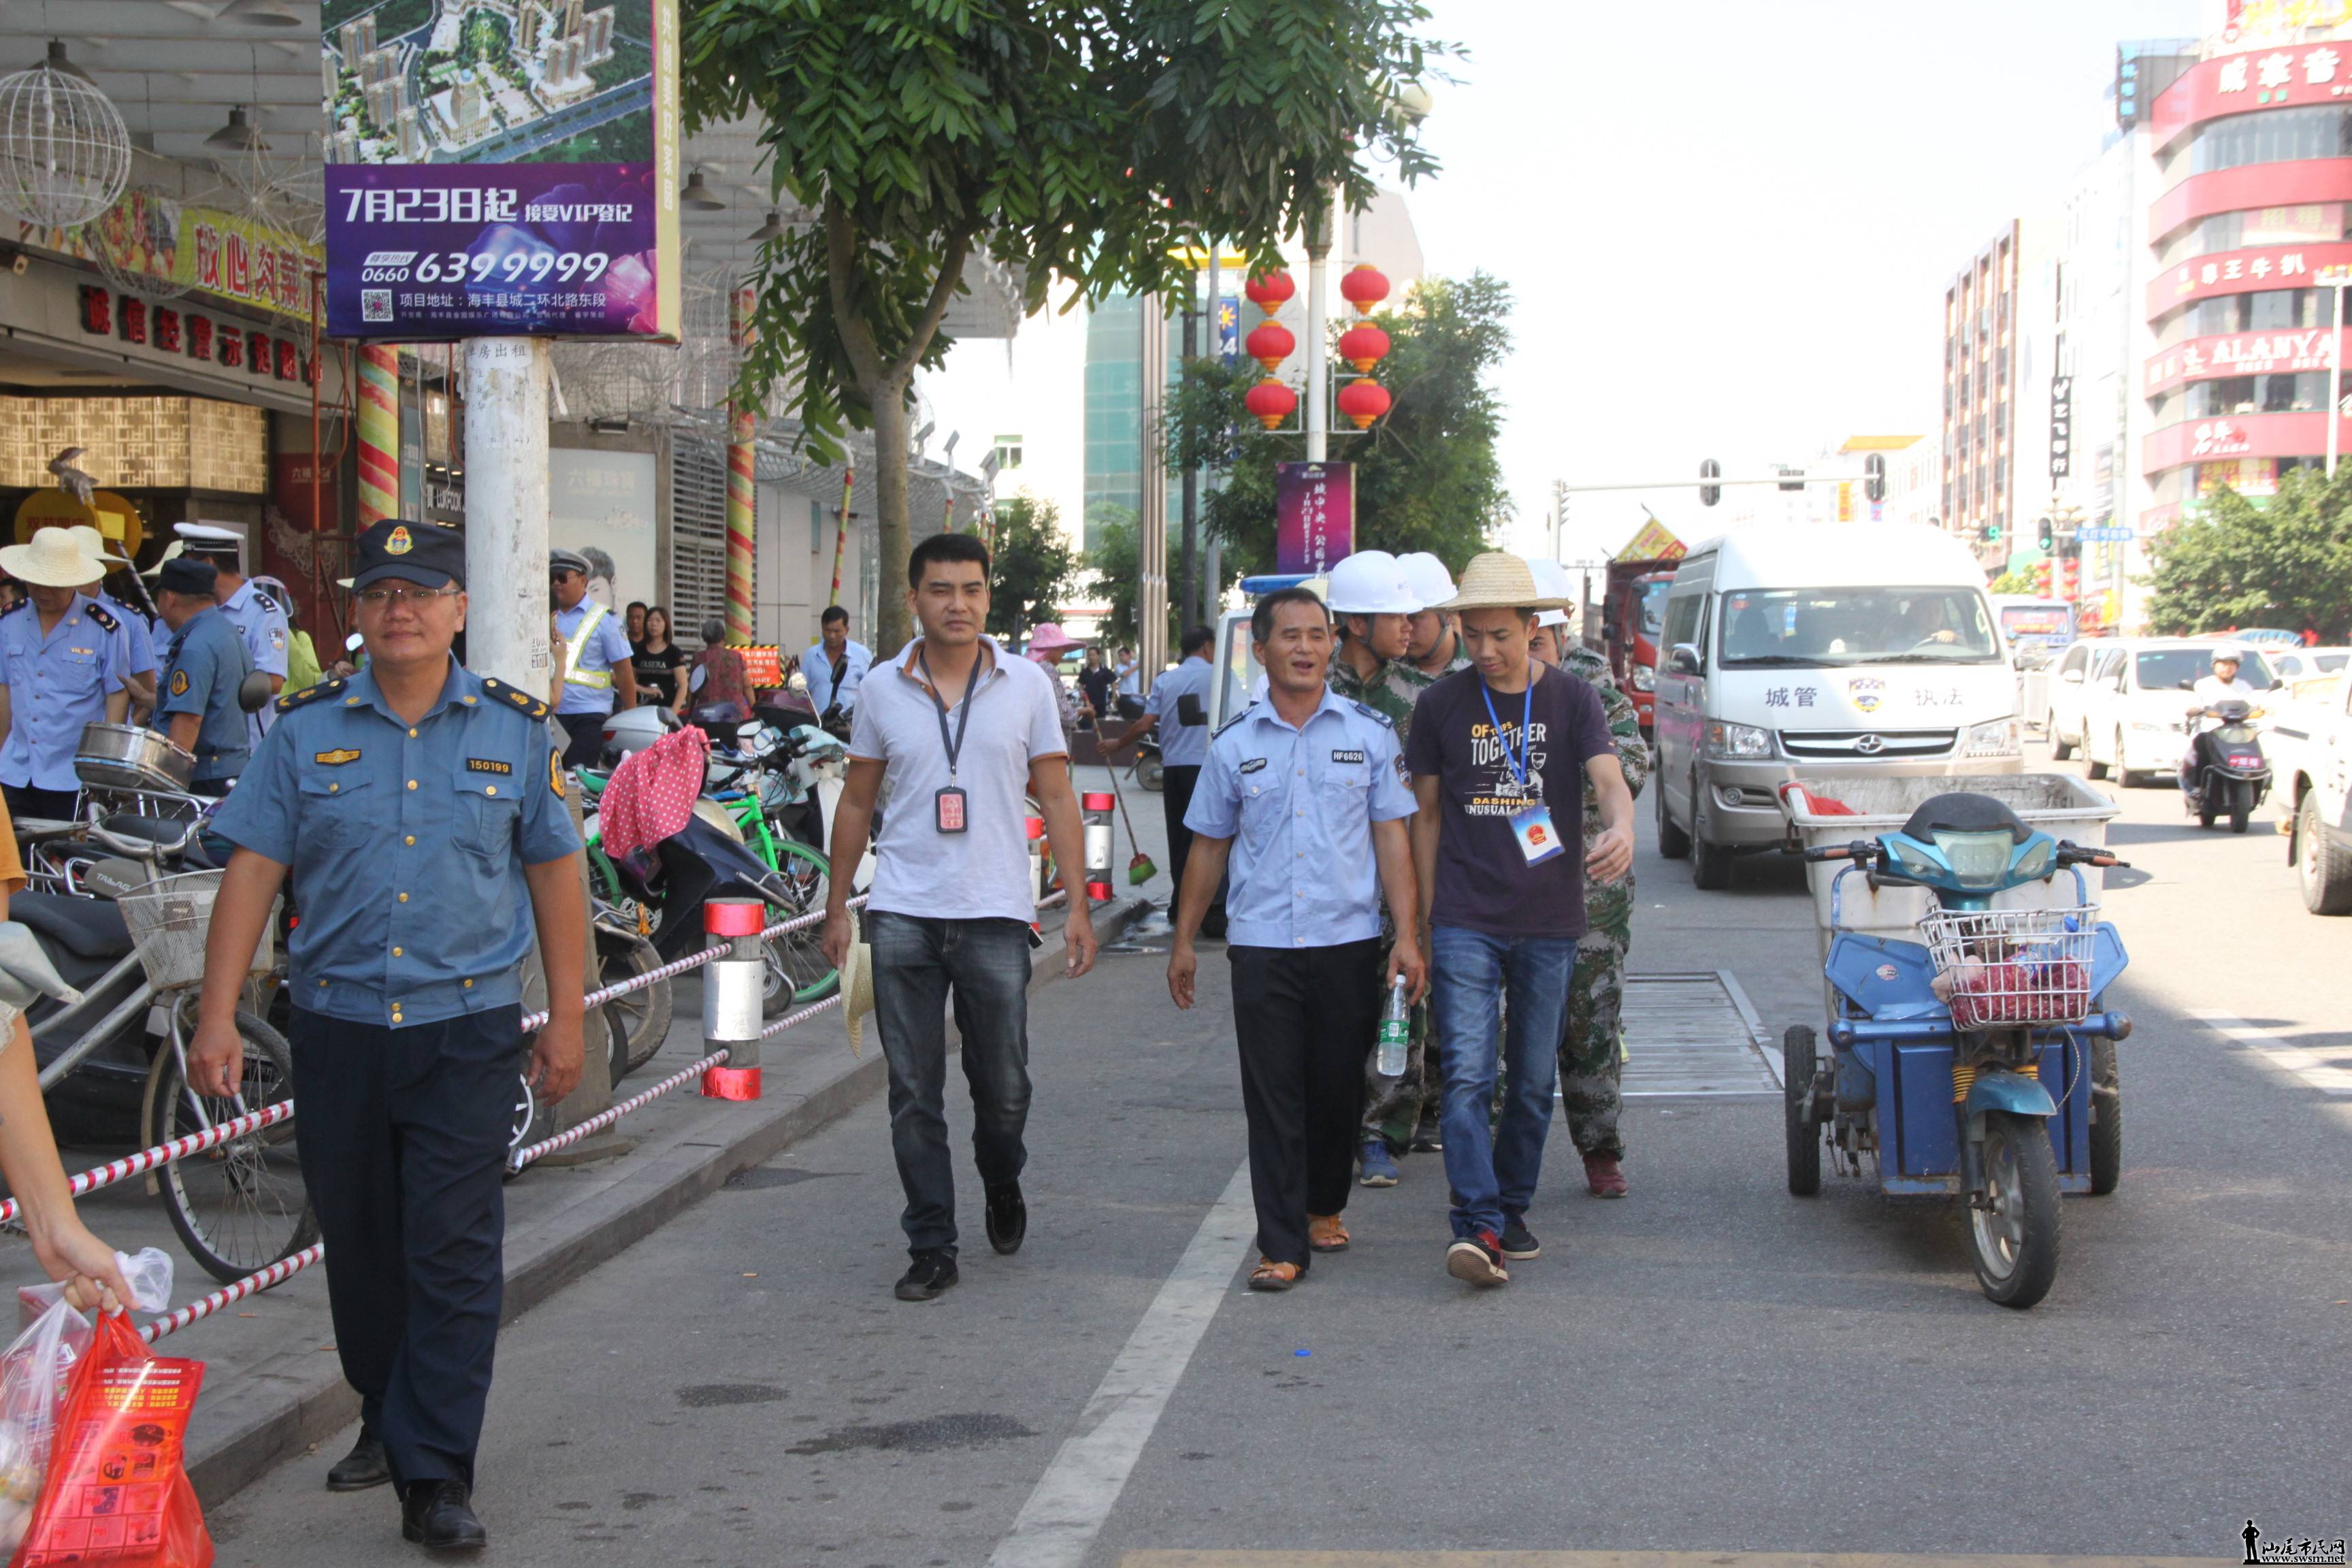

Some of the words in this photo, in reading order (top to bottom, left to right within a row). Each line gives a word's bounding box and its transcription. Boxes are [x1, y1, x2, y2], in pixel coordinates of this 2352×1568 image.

[340, 187, 517, 223] 7月23日起
[525, 204, 633, 223] 接受VIP登记
[361, 267, 410, 282] 0660
[399, 293, 606, 308] 项目地址：海丰县城二环北路东段
[1988, 525, 2001, 542] 9
[1765, 687, 1818, 708] 城管
[1914, 687, 1965, 706] 执法
[1471, 723, 1490, 738] OF
[470, 760, 509, 773] 150199
[1472, 798, 1536, 806] DASHING
